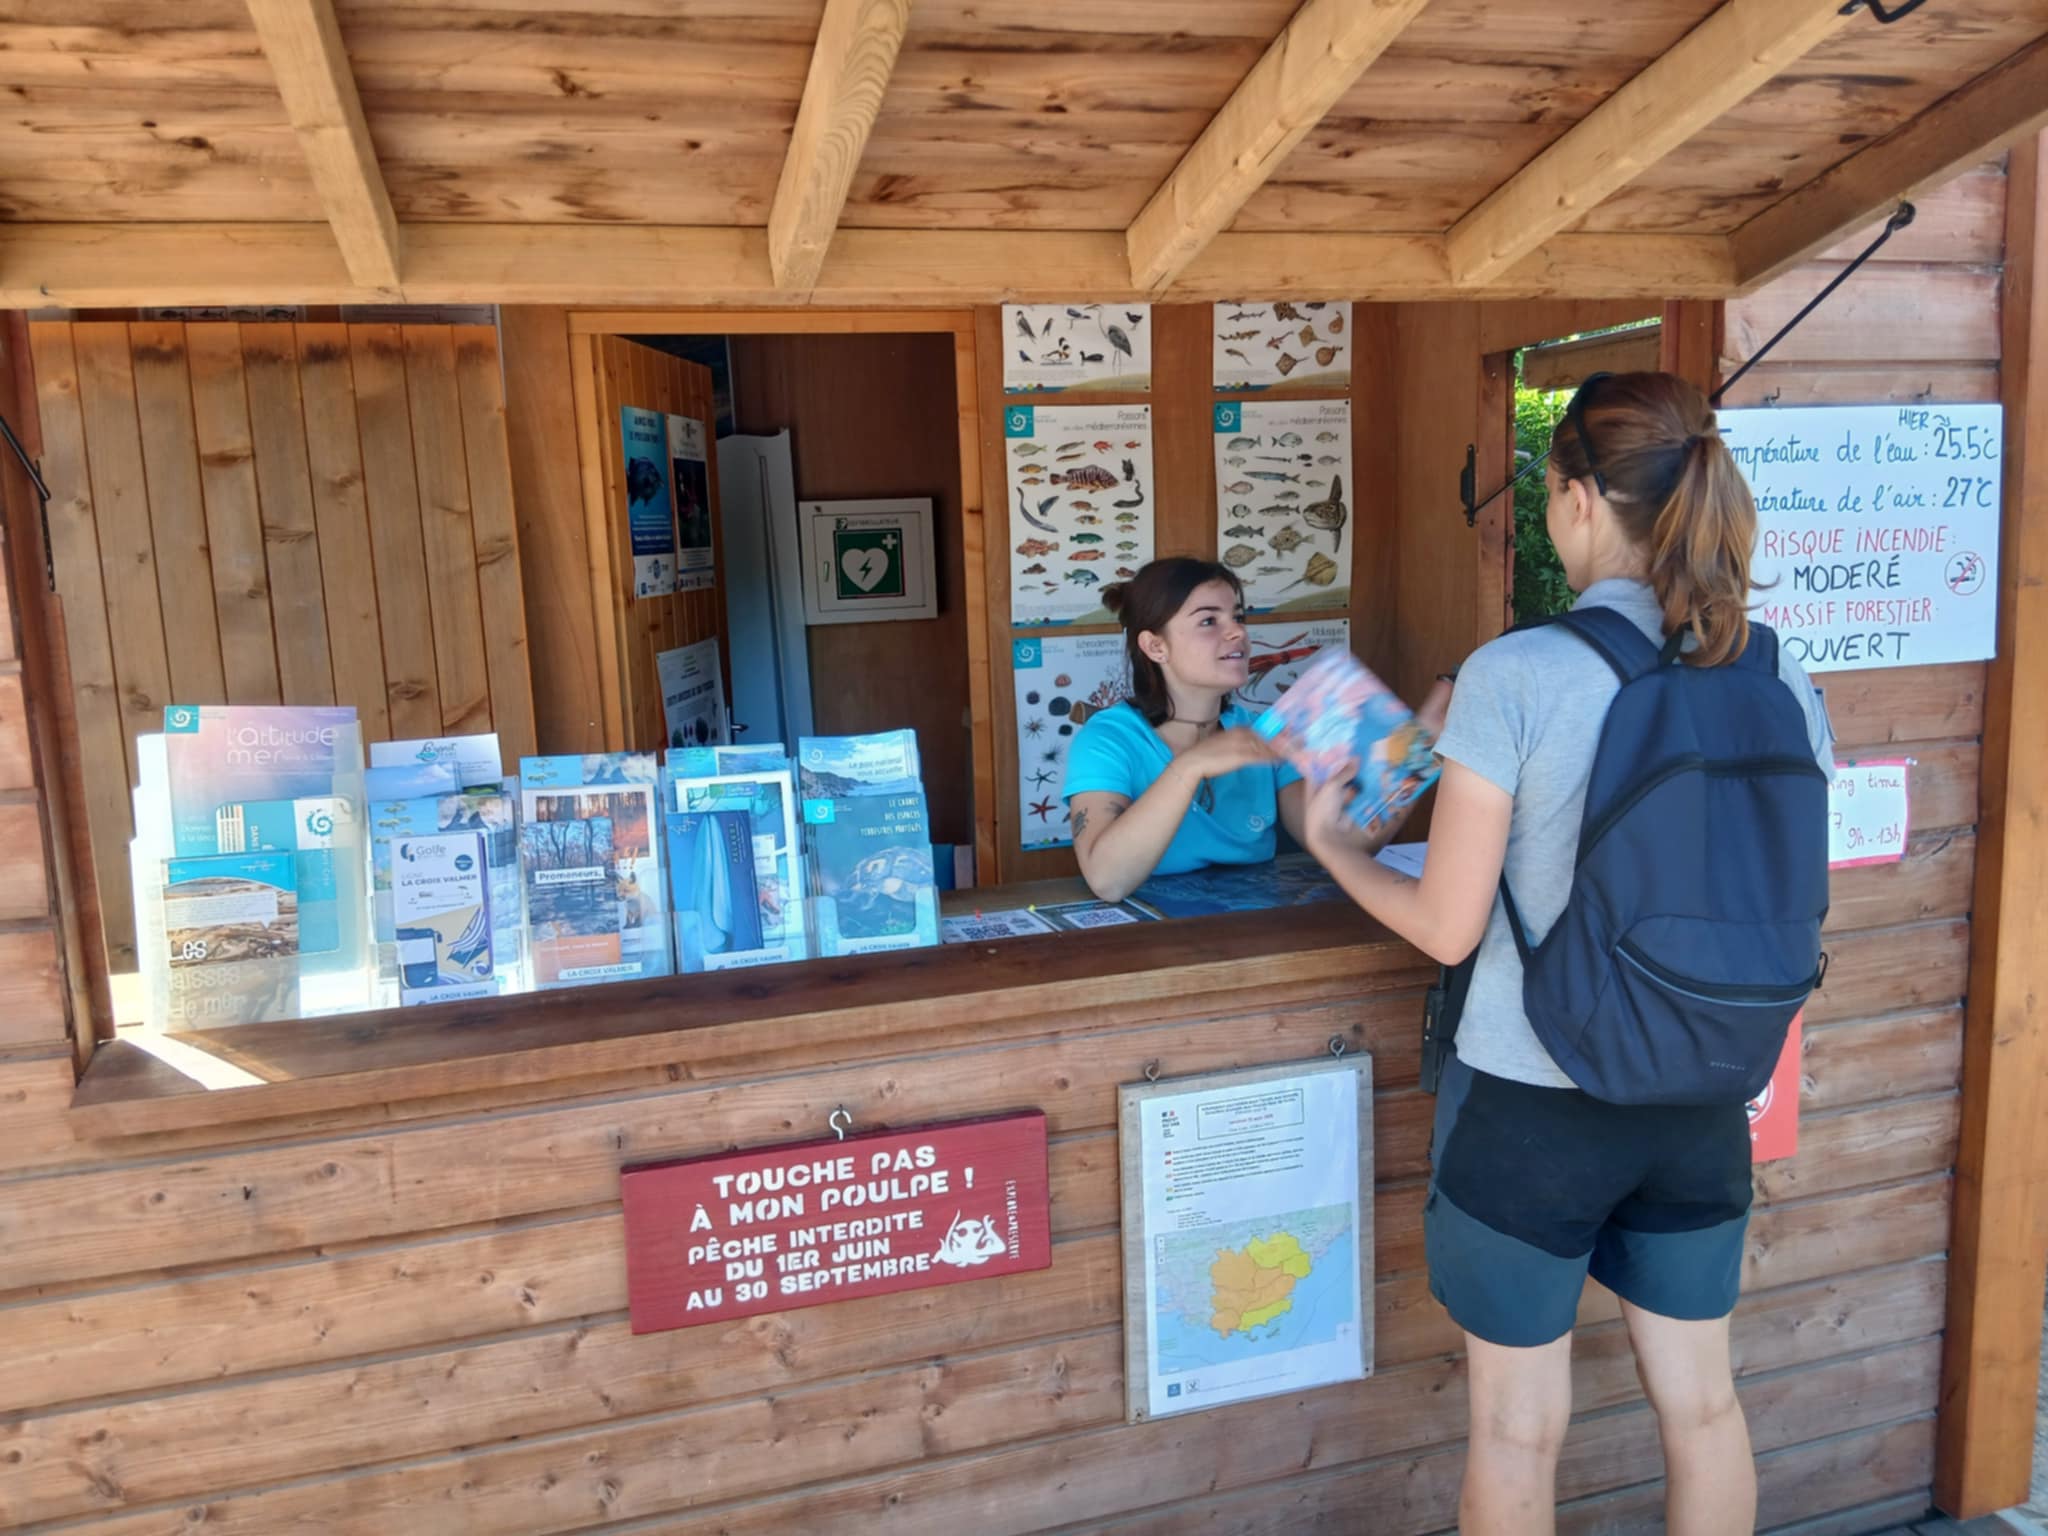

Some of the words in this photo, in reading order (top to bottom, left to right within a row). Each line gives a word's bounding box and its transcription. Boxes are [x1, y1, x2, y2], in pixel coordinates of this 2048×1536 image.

[1899, 408, 1929, 430] HIER
[1837, 429, 1861, 463] de
[1837, 485, 1863, 513] de
[1794, 555, 1901, 593] MODERÉ
[1764, 601, 1835, 630] MASSIF
[713, 1157, 855, 1199] TOUCHE
[872, 1145, 936, 1176] PAS
[690, 1204, 712, 1233] À
[730, 1192, 804, 1228] MON
[821, 1170, 949, 1212] POULPE
[964, 1167, 975, 1189] !
[688, 1233, 777, 1265] PÊCHE
[790, 1210, 923, 1247] INTERDITE
[725, 1257, 762, 1282] DU
[777, 1251, 819, 1273] 1ER
[835, 1238, 890, 1263] JUIN
[686, 1287, 722, 1312] AU
[735, 1280, 768, 1301] 30
[781, 1253, 931, 1295] SEPTEMBRE
